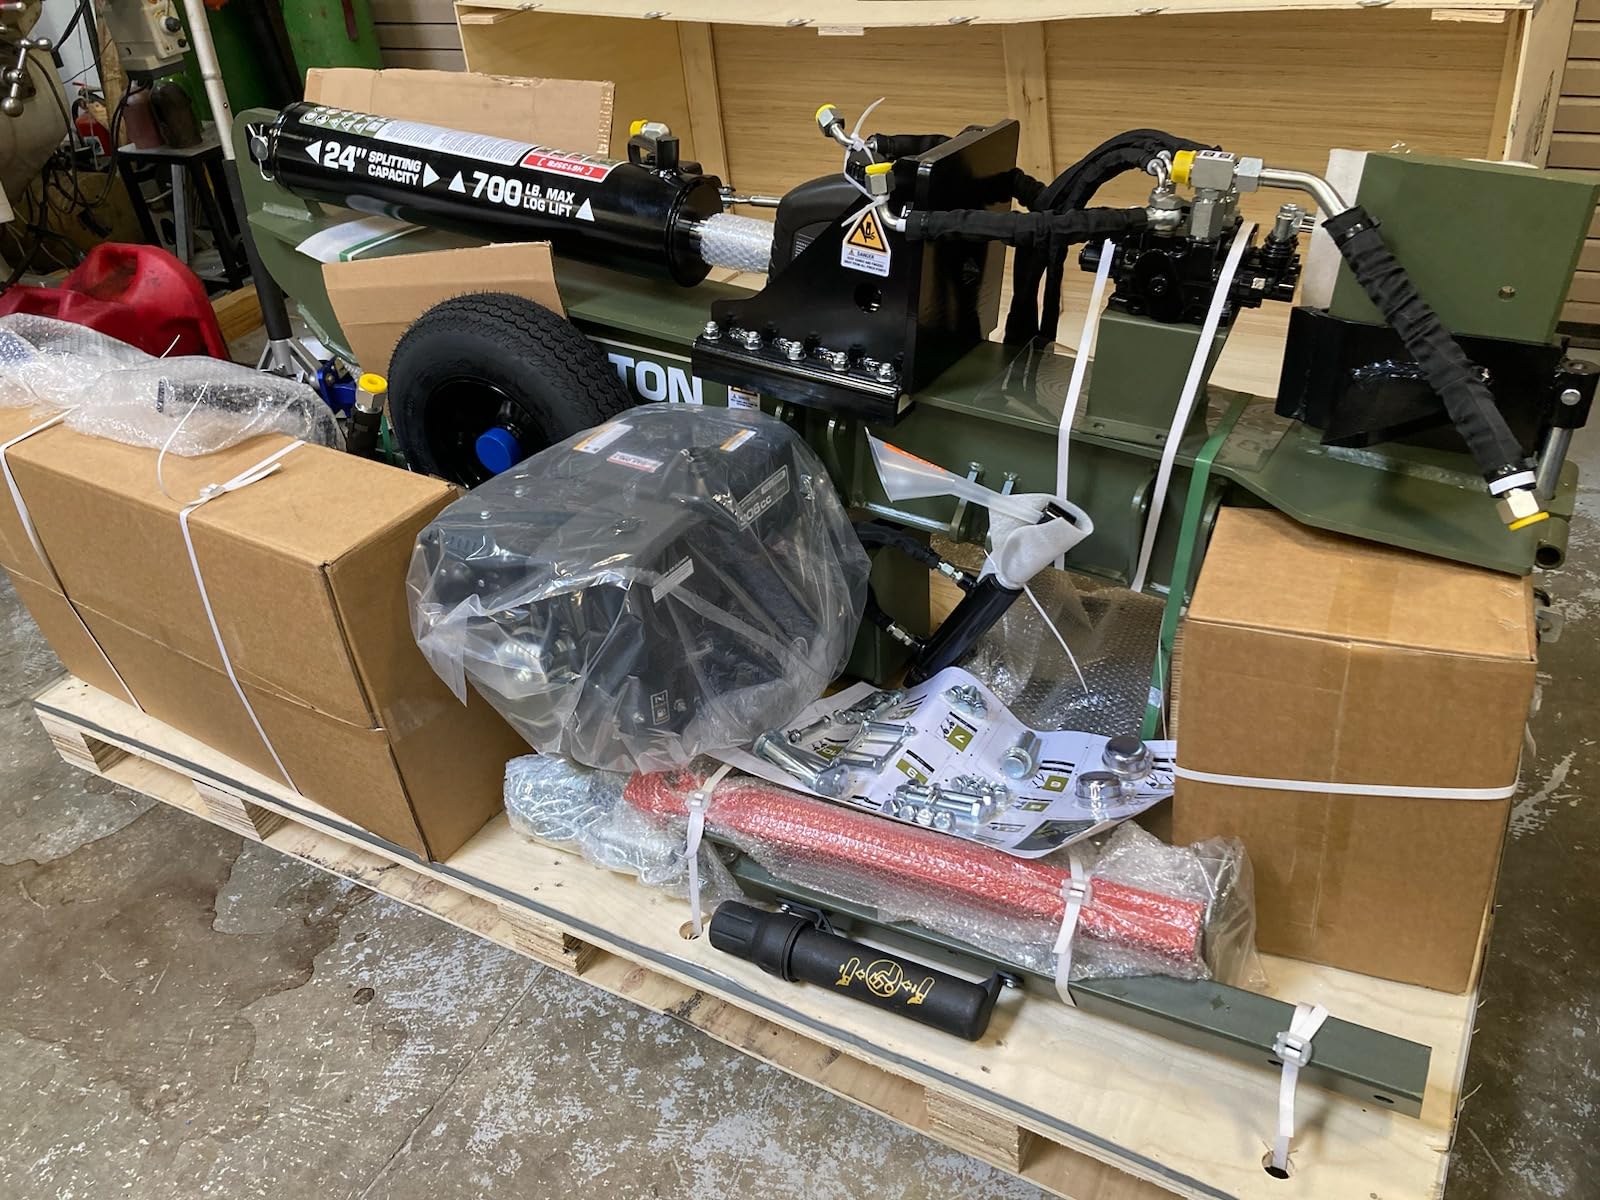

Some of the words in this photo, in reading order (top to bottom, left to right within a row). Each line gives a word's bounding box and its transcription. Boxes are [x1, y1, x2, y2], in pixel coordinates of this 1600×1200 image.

[323, 141, 367, 173] 24"
[367, 150, 422, 173] SPLITTING
[367, 164, 420, 186] CAPACITY
[472, 170, 523, 207] 700
[524, 182, 542, 198] LB.
[546, 187, 576, 204] MAX
[523, 197, 545, 212] LOG
[548, 202, 572, 218] LIFT
[608, 352, 703, 406] TON
